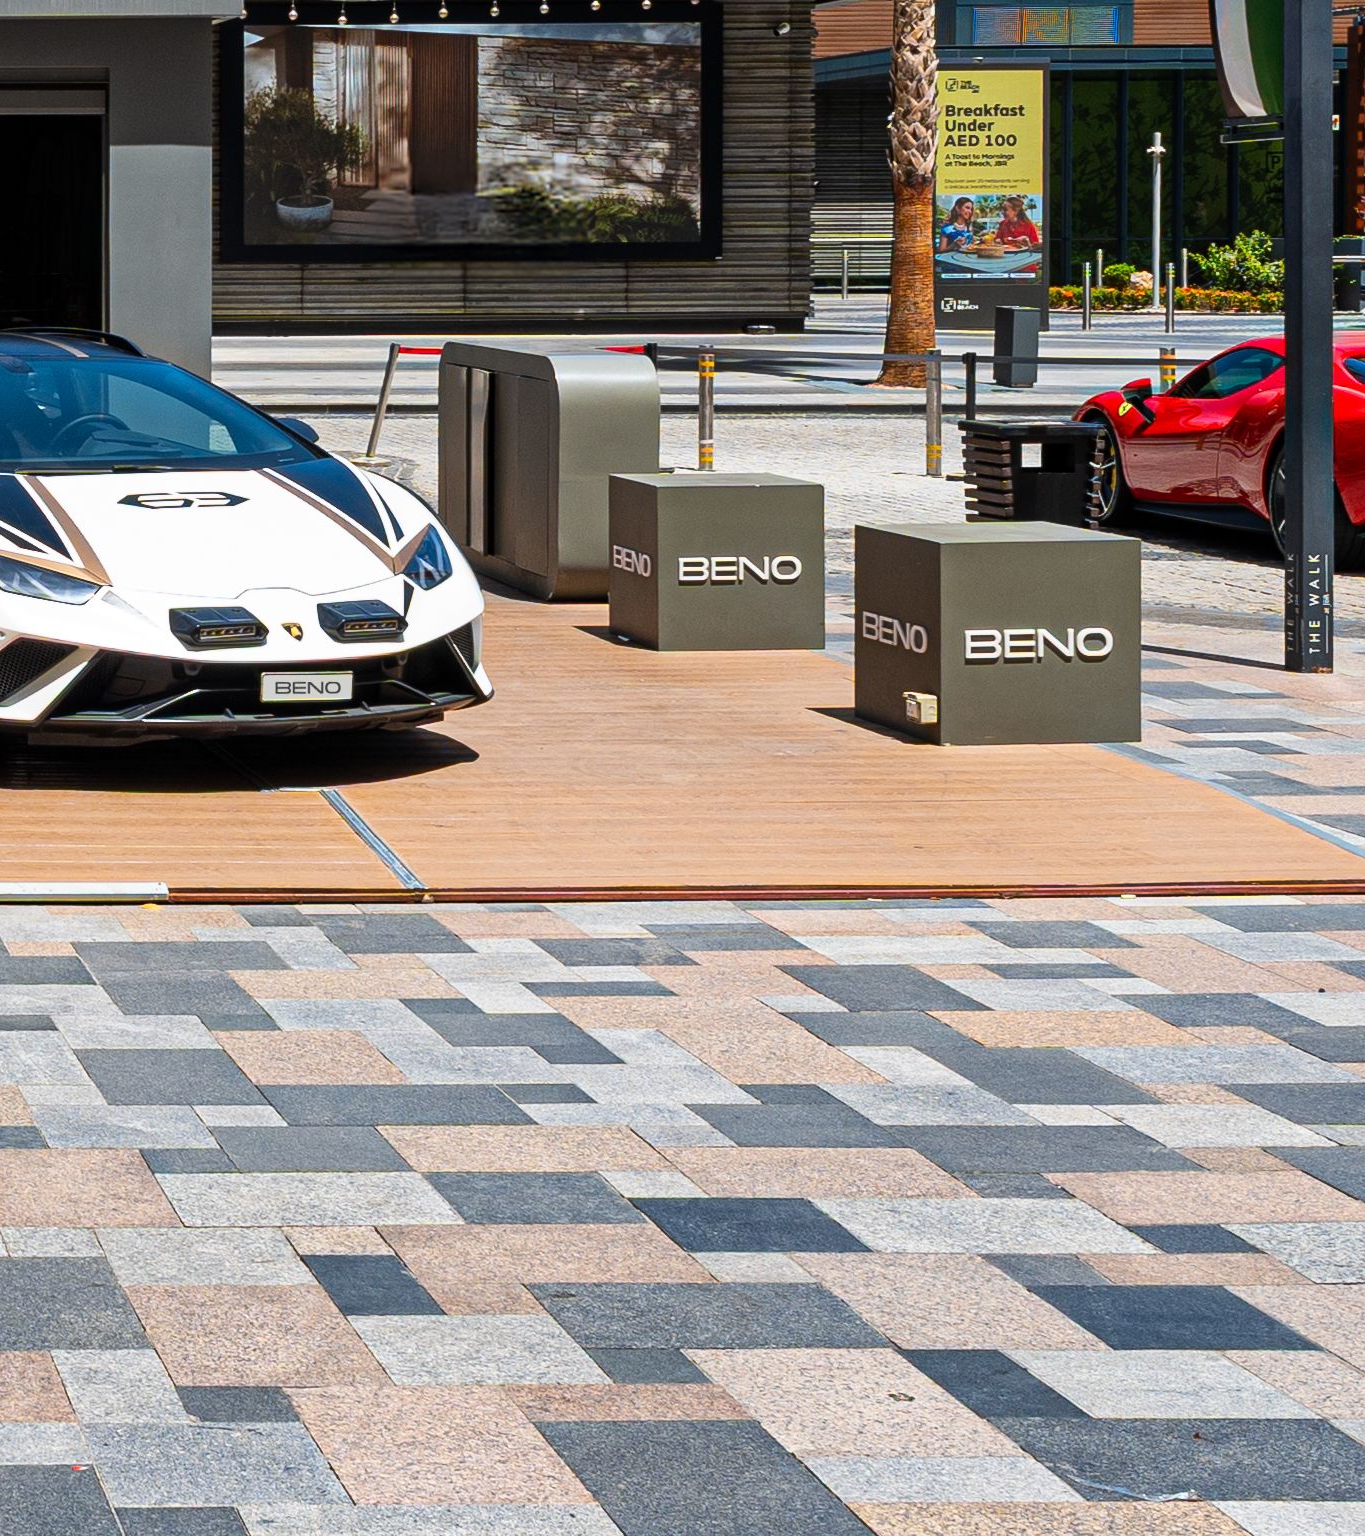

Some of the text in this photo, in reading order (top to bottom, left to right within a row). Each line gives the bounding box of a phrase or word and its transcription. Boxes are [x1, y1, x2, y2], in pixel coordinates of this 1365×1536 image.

[945, 104, 1025, 117] Breakfast
[945, 119, 995, 132] Under
[944, 134, 1017, 147] AED 100
[982, 153, 1015, 161] Mornings
[613, 545, 651, 578] BENO
[678, 555, 802, 581] BENO
[1308, 554, 1321, 654] THE WALK
[862, 611, 928, 654] BENO
[964, 627, 1114, 659] BENO
[275, 681, 341, 695] BENO
